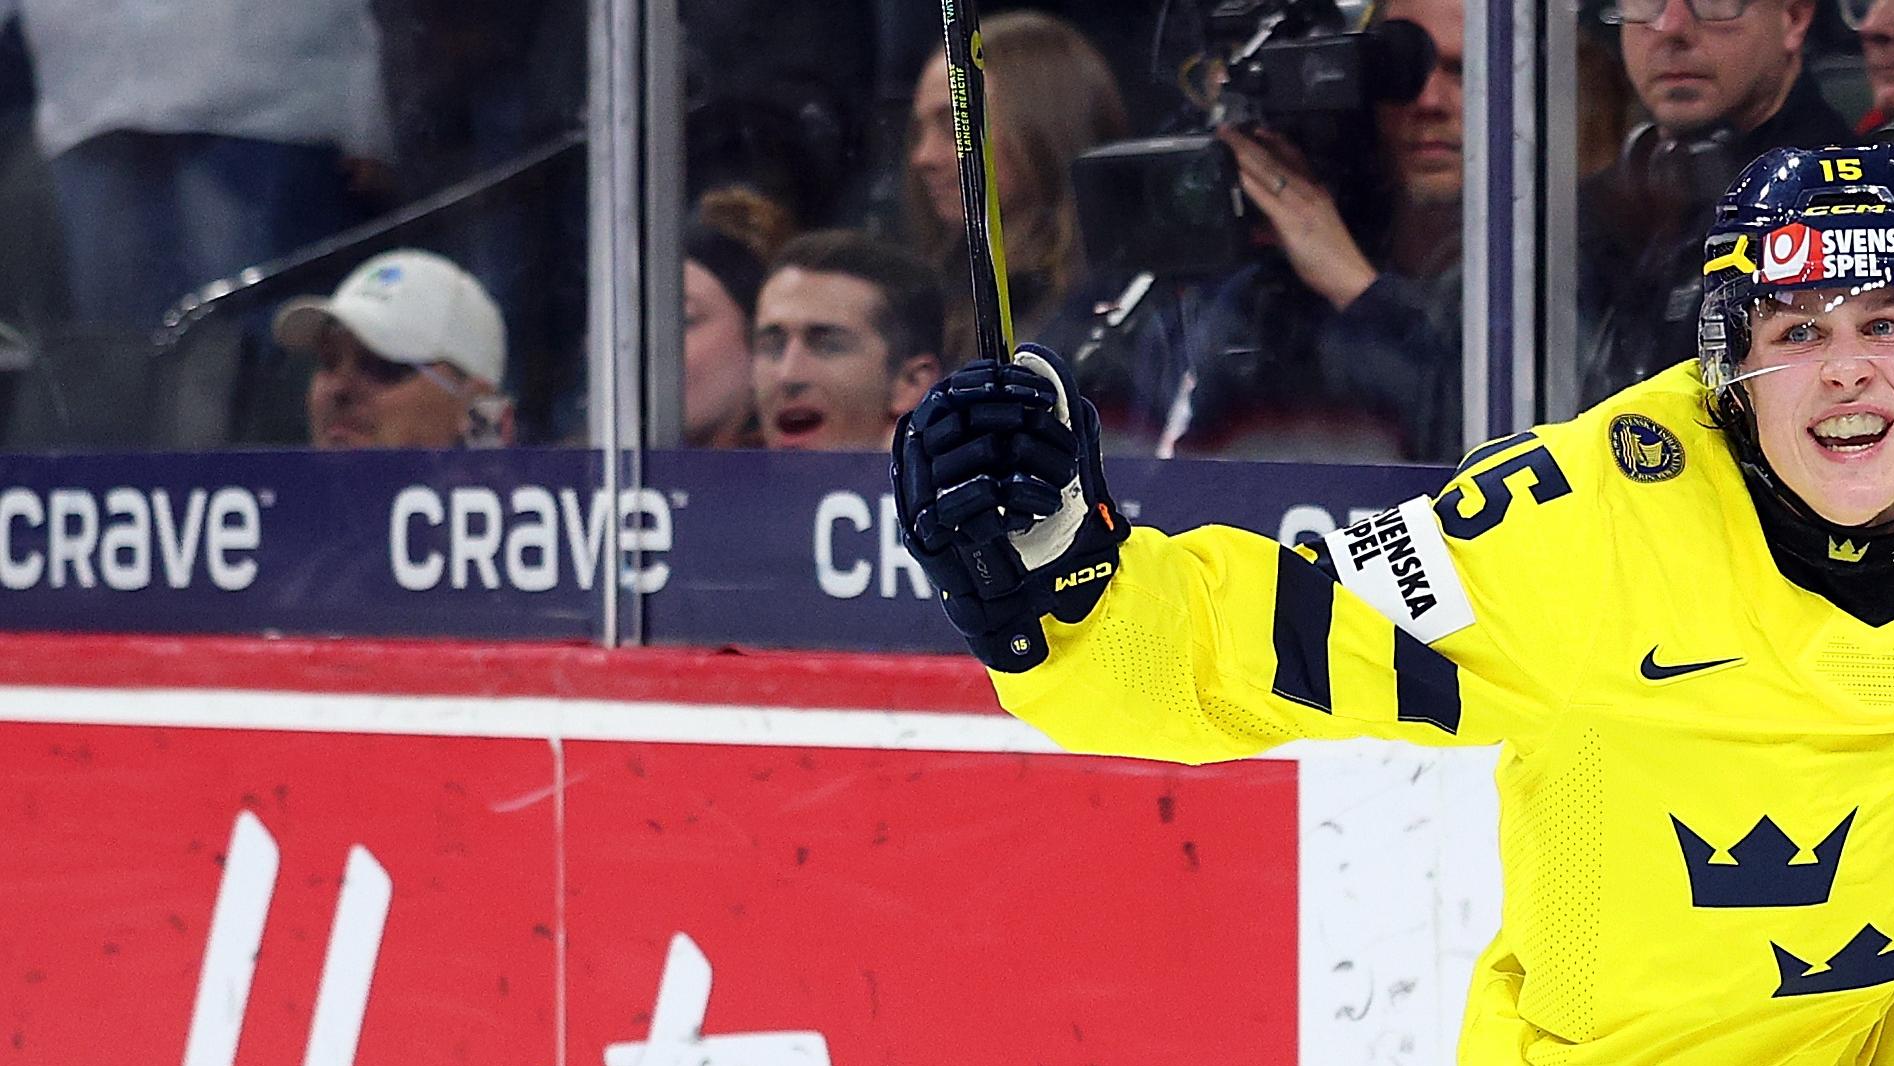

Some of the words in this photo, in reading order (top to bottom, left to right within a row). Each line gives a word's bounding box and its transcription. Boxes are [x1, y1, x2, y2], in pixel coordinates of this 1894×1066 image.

[1819, 158, 1863, 182] 15
[1804, 203, 1886, 217] CCM
[1822, 254, 1883, 279] SPEL
[1343, 517, 1382, 572] PEL
[1372, 507, 1437, 620] VENSKA
[1055, 562, 1112, 591] CCM
[1013, 638, 1028, 651] 15
